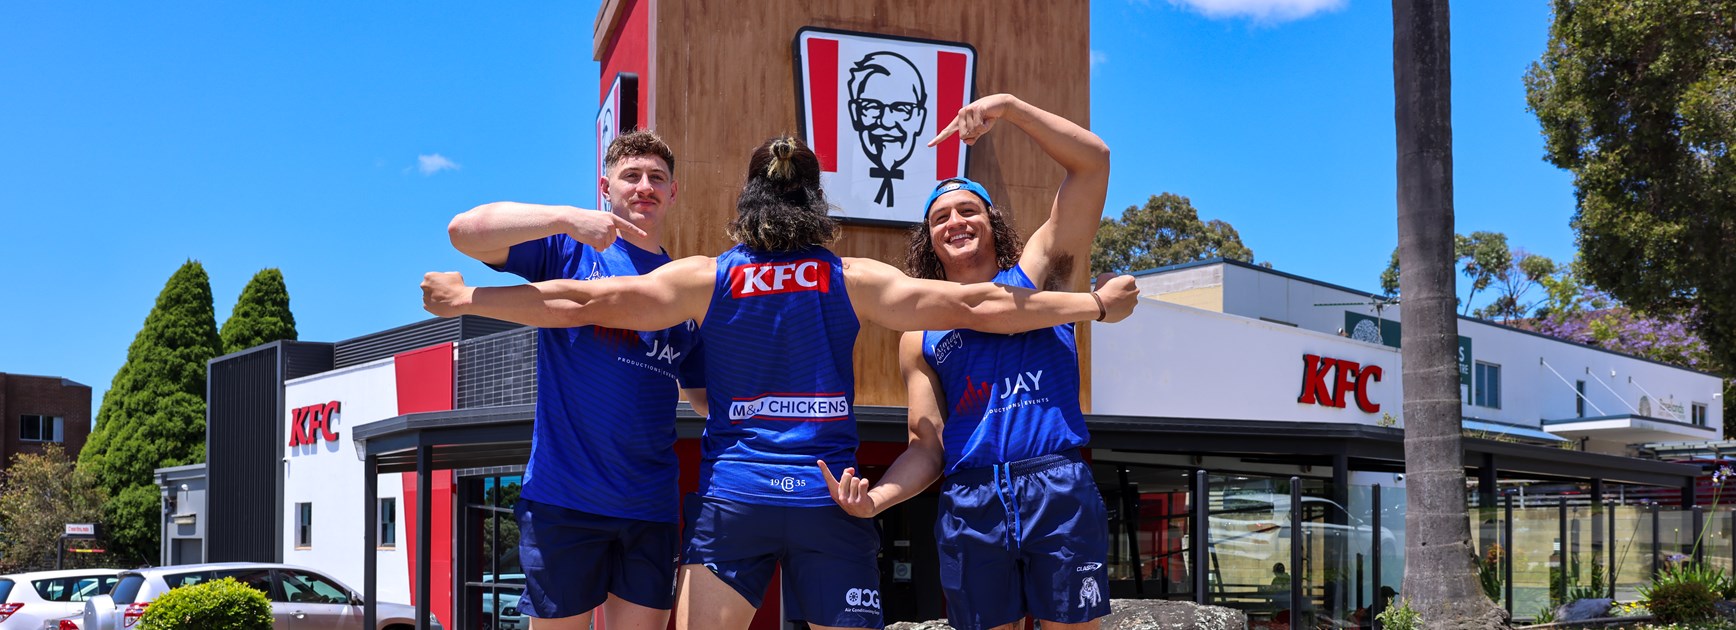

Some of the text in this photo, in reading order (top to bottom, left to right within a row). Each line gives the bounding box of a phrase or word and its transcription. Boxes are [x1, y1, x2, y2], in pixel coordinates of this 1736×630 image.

[741, 261, 818, 294] KFC
[617, 356, 661, 373] PRODUCTIONS
[1000, 370, 1043, 399] JAY
[1297, 354, 1383, 414] KFC
[768, 400, 846, 414] CHICKENS
[1024, 397, 1049, 406] EVENTS
[289, 400, 342, 447] KFC
[770, 478, 780, 486] 19
[795, 479, 806, 487] 35
